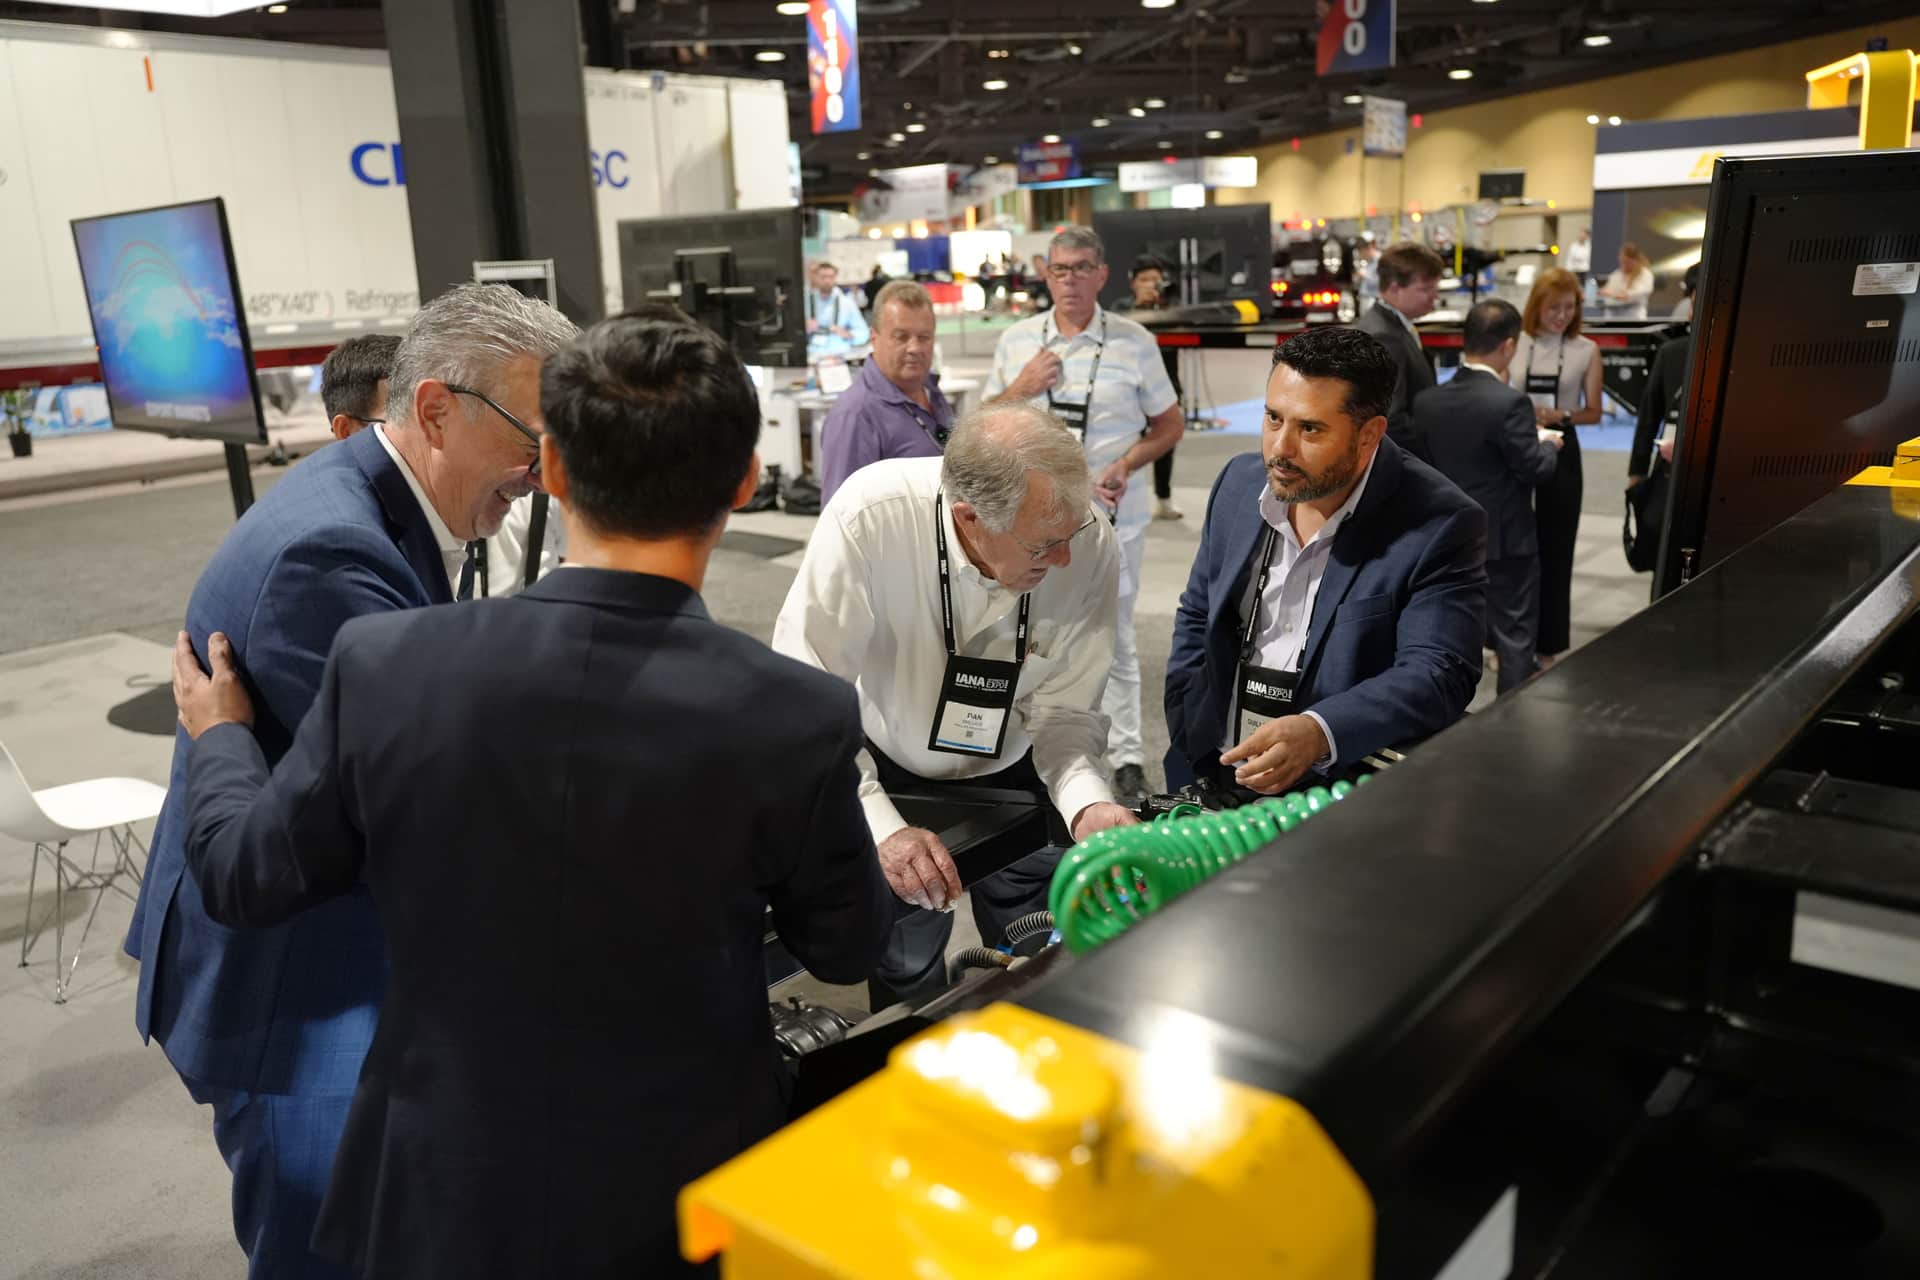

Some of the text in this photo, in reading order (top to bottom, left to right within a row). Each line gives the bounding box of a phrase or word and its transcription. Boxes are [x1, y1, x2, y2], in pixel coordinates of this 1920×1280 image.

[955, 672, 985, 687] IANA
[1246, 680, 1267, 694] IANA
[1268, 688, 1288, 698] EXPO
